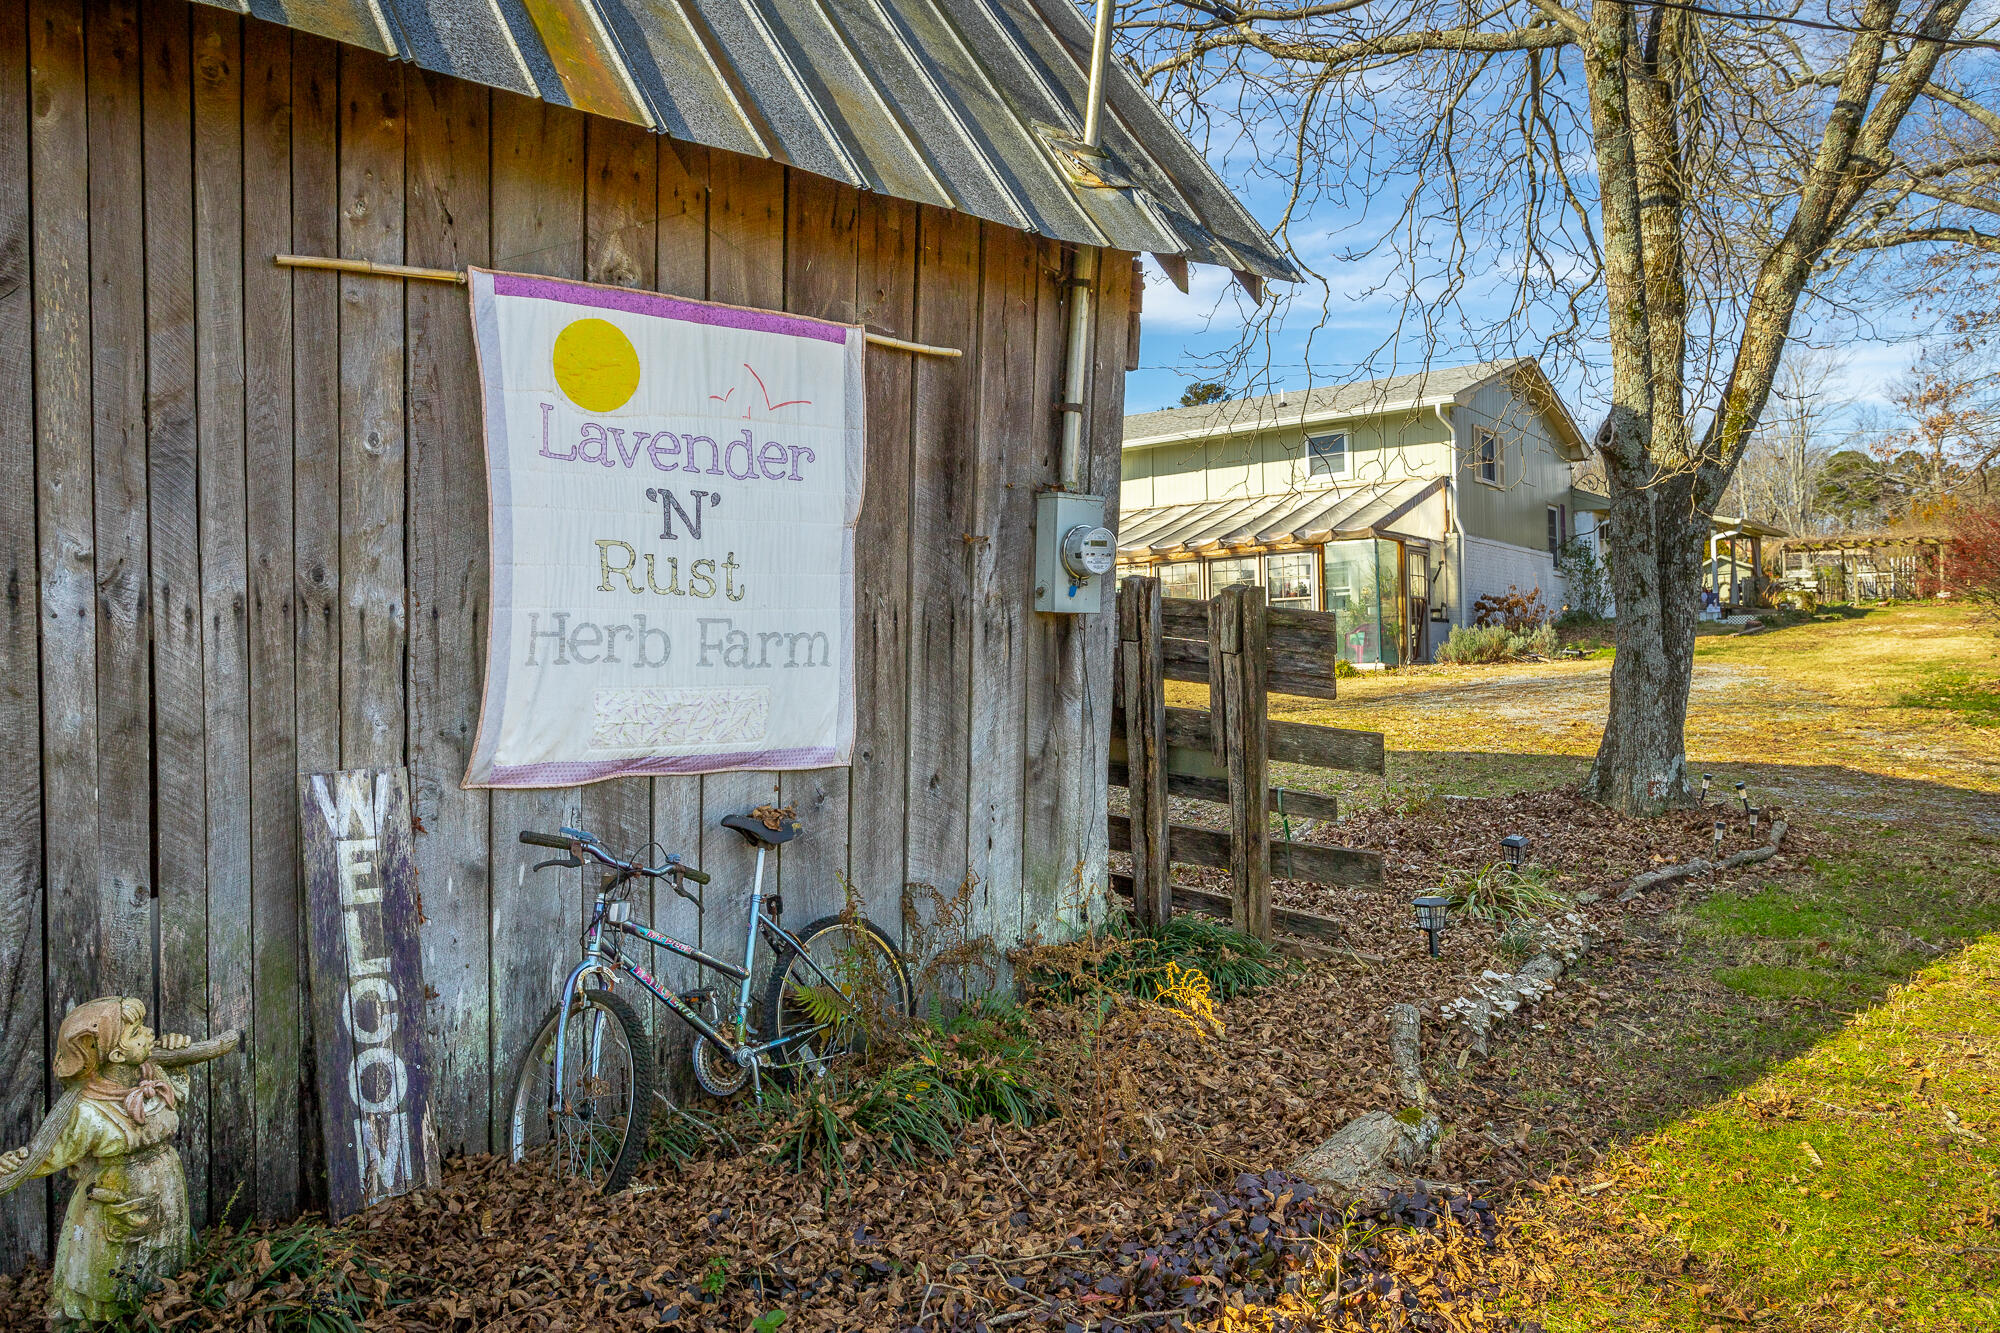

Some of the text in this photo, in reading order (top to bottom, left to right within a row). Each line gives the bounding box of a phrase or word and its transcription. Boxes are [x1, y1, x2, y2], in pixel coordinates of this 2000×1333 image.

[539, 402, 816, 482] Lavender
[595, 539, 745, 602] Rust
[524, 612, 832, 669] Herb Farm
[310, 773, 412, 1206] WELCOM
